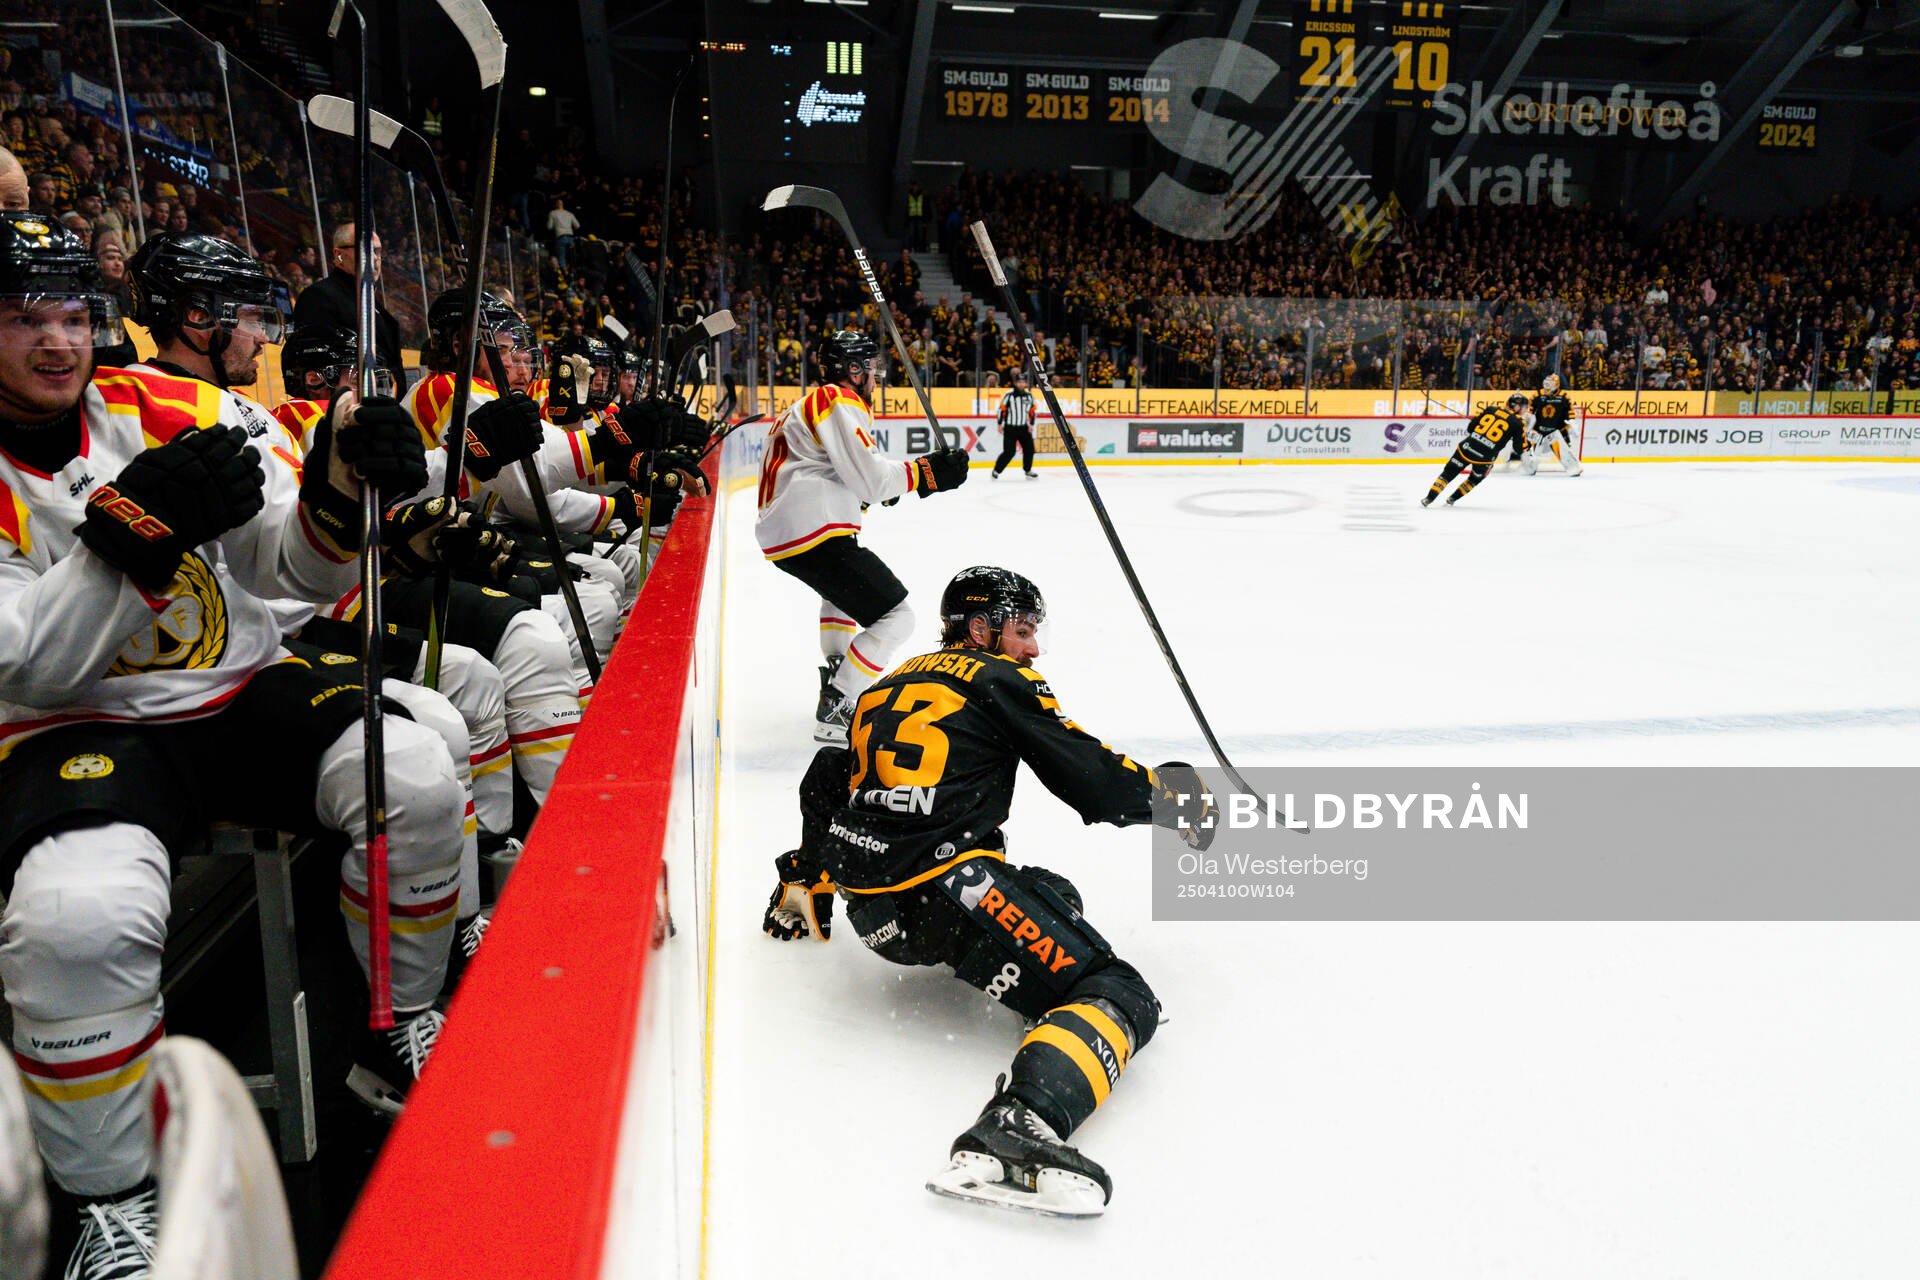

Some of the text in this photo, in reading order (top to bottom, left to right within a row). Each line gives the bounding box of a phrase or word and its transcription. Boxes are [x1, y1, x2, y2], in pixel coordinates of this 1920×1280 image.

[1305, 21, 1355, 33] ERICSSON
[1392, 24, 1450, 37] LINDSTRÖM
[1300, 36, 1357, 87] 21
[1393, 41, 1449, 91] 10
[944, 70, 1008, 86] SM-GULD
[1026, 73, 1089, 89] SM-GULD
[1108, 77, 1170, 92] SM-GULD
[945, 91, 1008, 118] 1978
[1026, 94, 1089, 119] 2013
[1108, 97, 1170, 122] 2014
[1430, 80, 1720, 142] Skellefteå
[1505, 101, 1690, 128] NORTH POWER
[1763, 106, 1817, 121] SM-GULD
[1759, 125, 1816, 148] 2024
[1426, 154, 1572, 209] Kraft
[854, 249, 886, 303] BAUER
[1024, 338, 1055, 392] CCM
[1085, 399, 1319, 415] SKELLEFTEAAIKSE/MEDLEM
[1159, 429, 1235, 447] valutec
[1267, 422, 1351, 443] Ductus
[1429, 427, 1468, 438] Skellefte
[1474, 413, 1509, 442] 96
[1625, 429, 1764, 445] HULTDINS JOB
[1779, 429, 1830, 439] GROUP
[1428, 438, 1451, 448] Kraft
[69, 473, 95, 497] SHL
[850, 682, 967, 796] 53
[979, 887, 1077, 974] REPAY
[41, 1030, 112, 1049] BAUER
